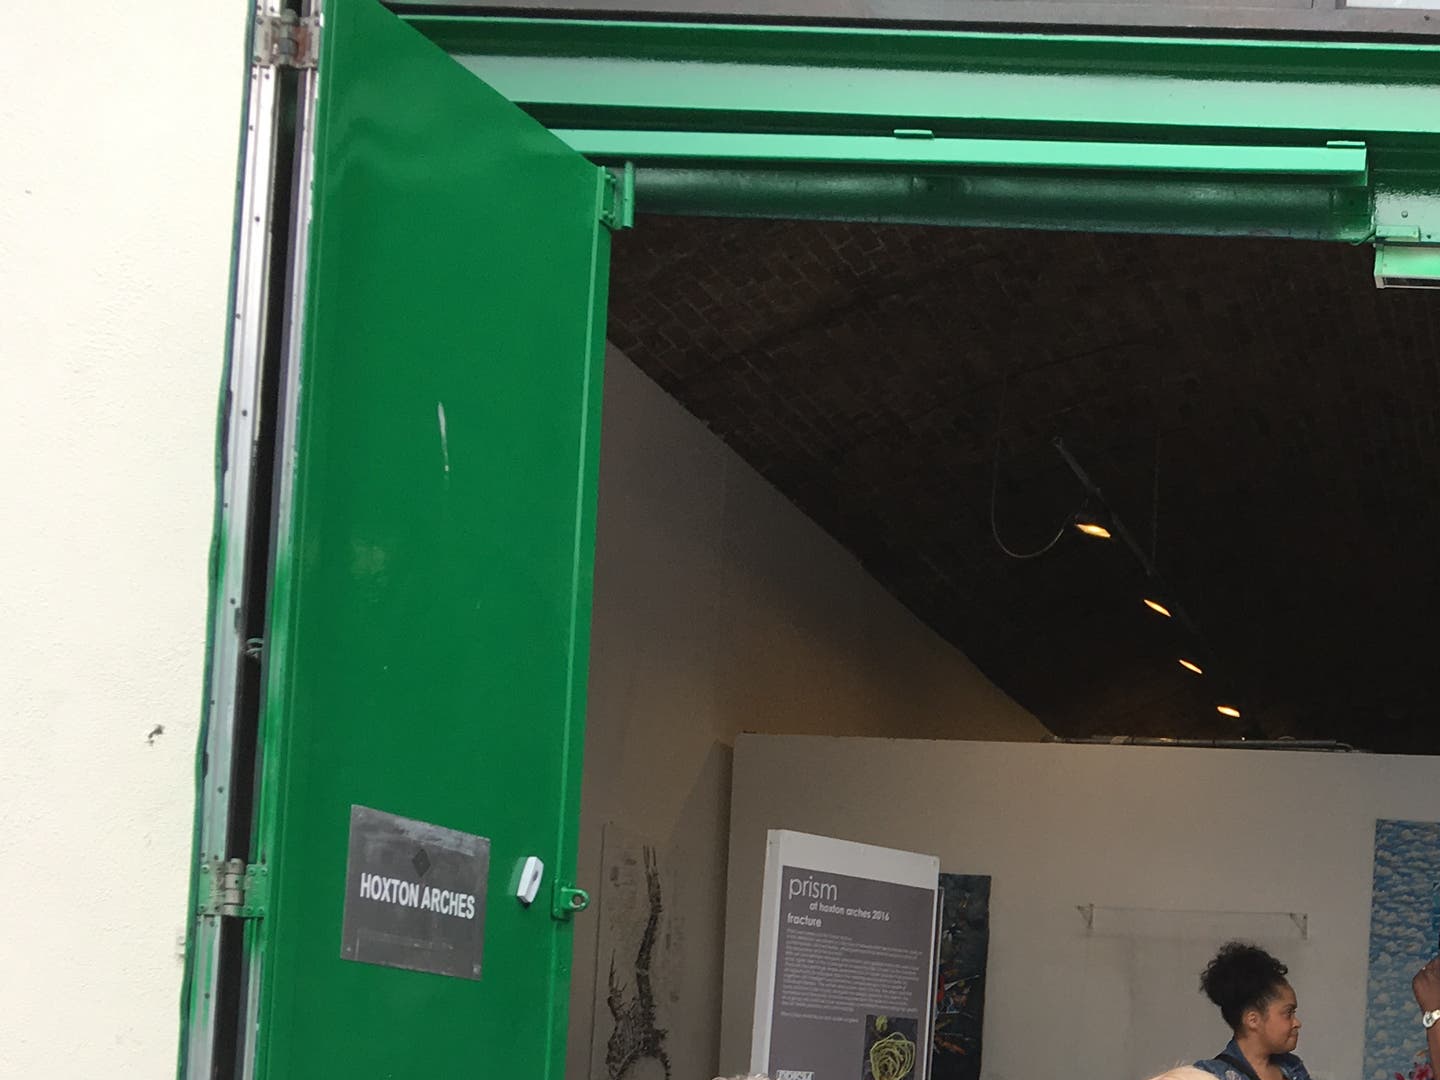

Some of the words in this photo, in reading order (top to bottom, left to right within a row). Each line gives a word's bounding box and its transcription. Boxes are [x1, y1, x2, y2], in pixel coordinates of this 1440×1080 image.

[360, 872, 420, 908] HOXTON
[420, 886, 476, 920] ARCHES
[788, 875, 838, 901] prism
[786, 912, 823, 928] fracture
[845, 907, 872, 919] arches
[872, 909, 891, 921] 2016
